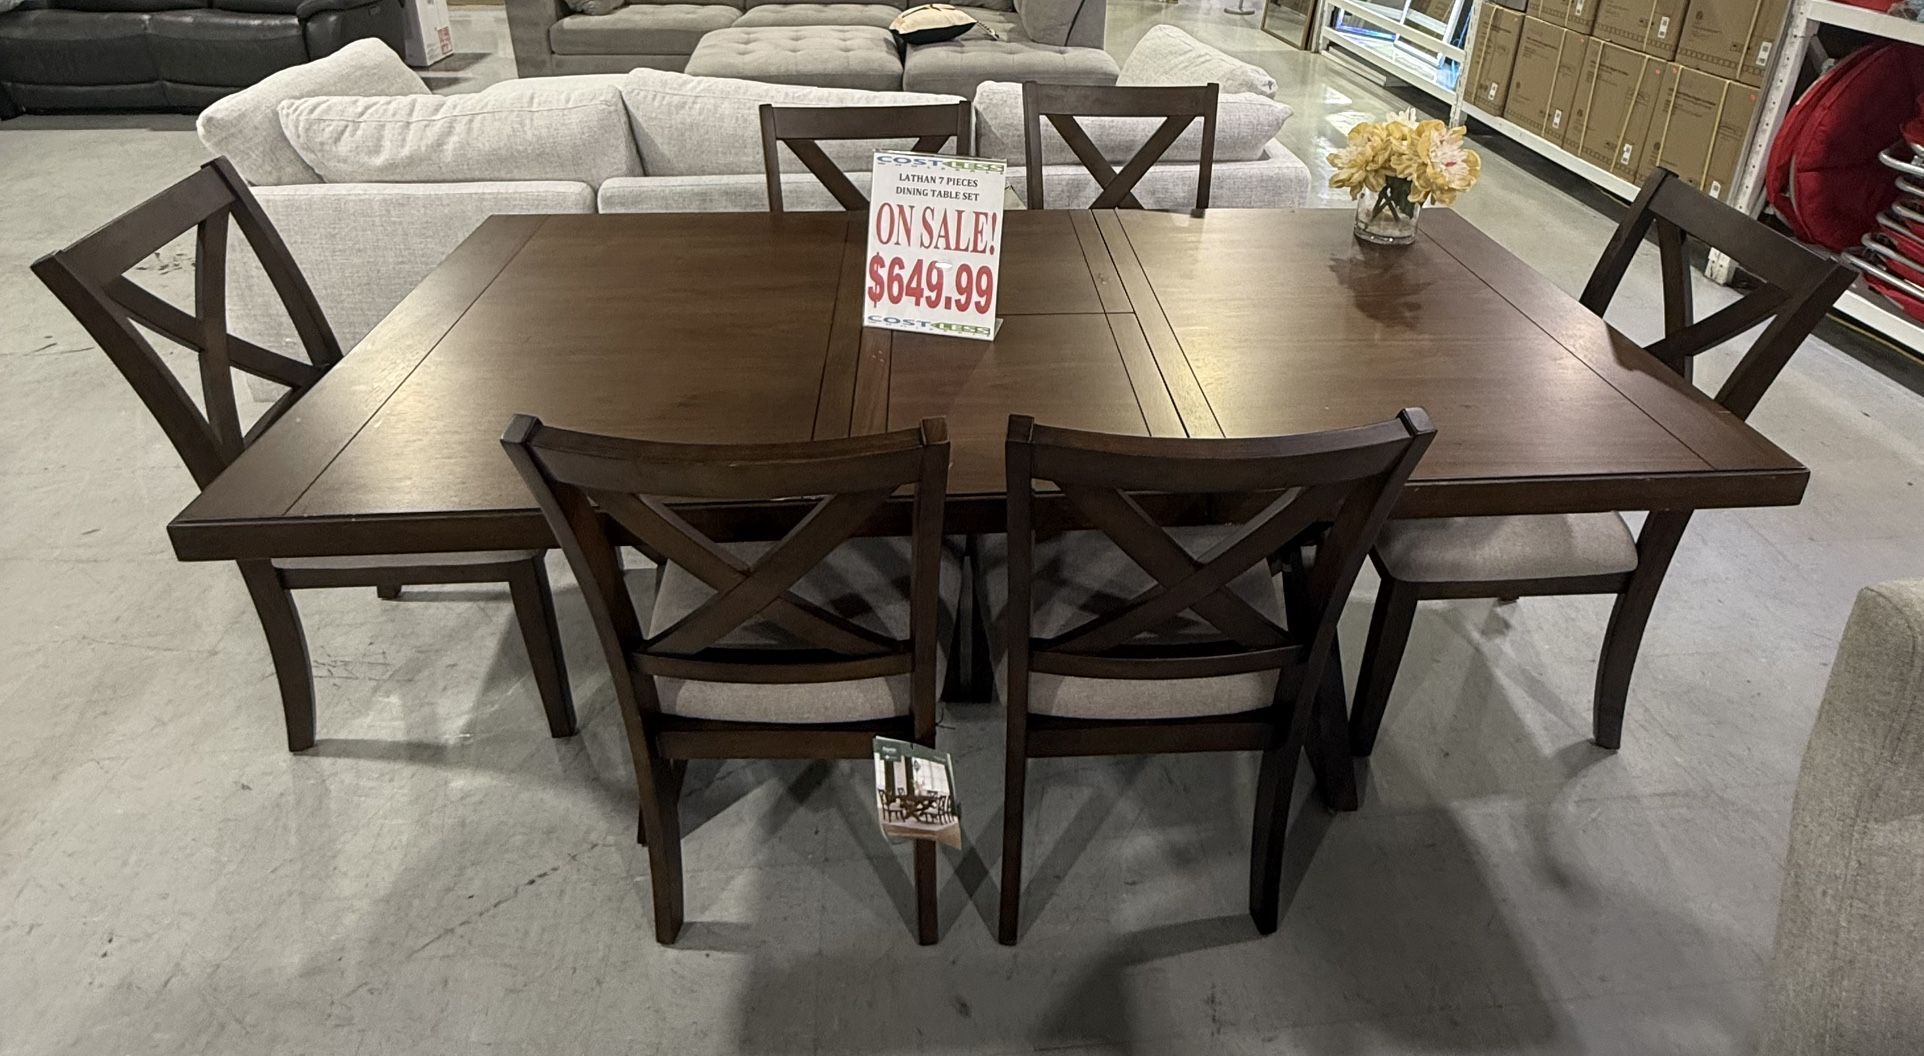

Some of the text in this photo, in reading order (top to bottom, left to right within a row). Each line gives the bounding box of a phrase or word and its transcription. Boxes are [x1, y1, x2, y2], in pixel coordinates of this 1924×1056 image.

[877, 156, 943, 167] COST
[899, 173, 978, 188] LATHAN 7 PIECES
[896, 186, 980, 201] DINING TABLE SET
[876, 202, 997, 256] ON SALE!
[867, 252, 994, 314] $649.99
[868, 315, 931, 328] COST
